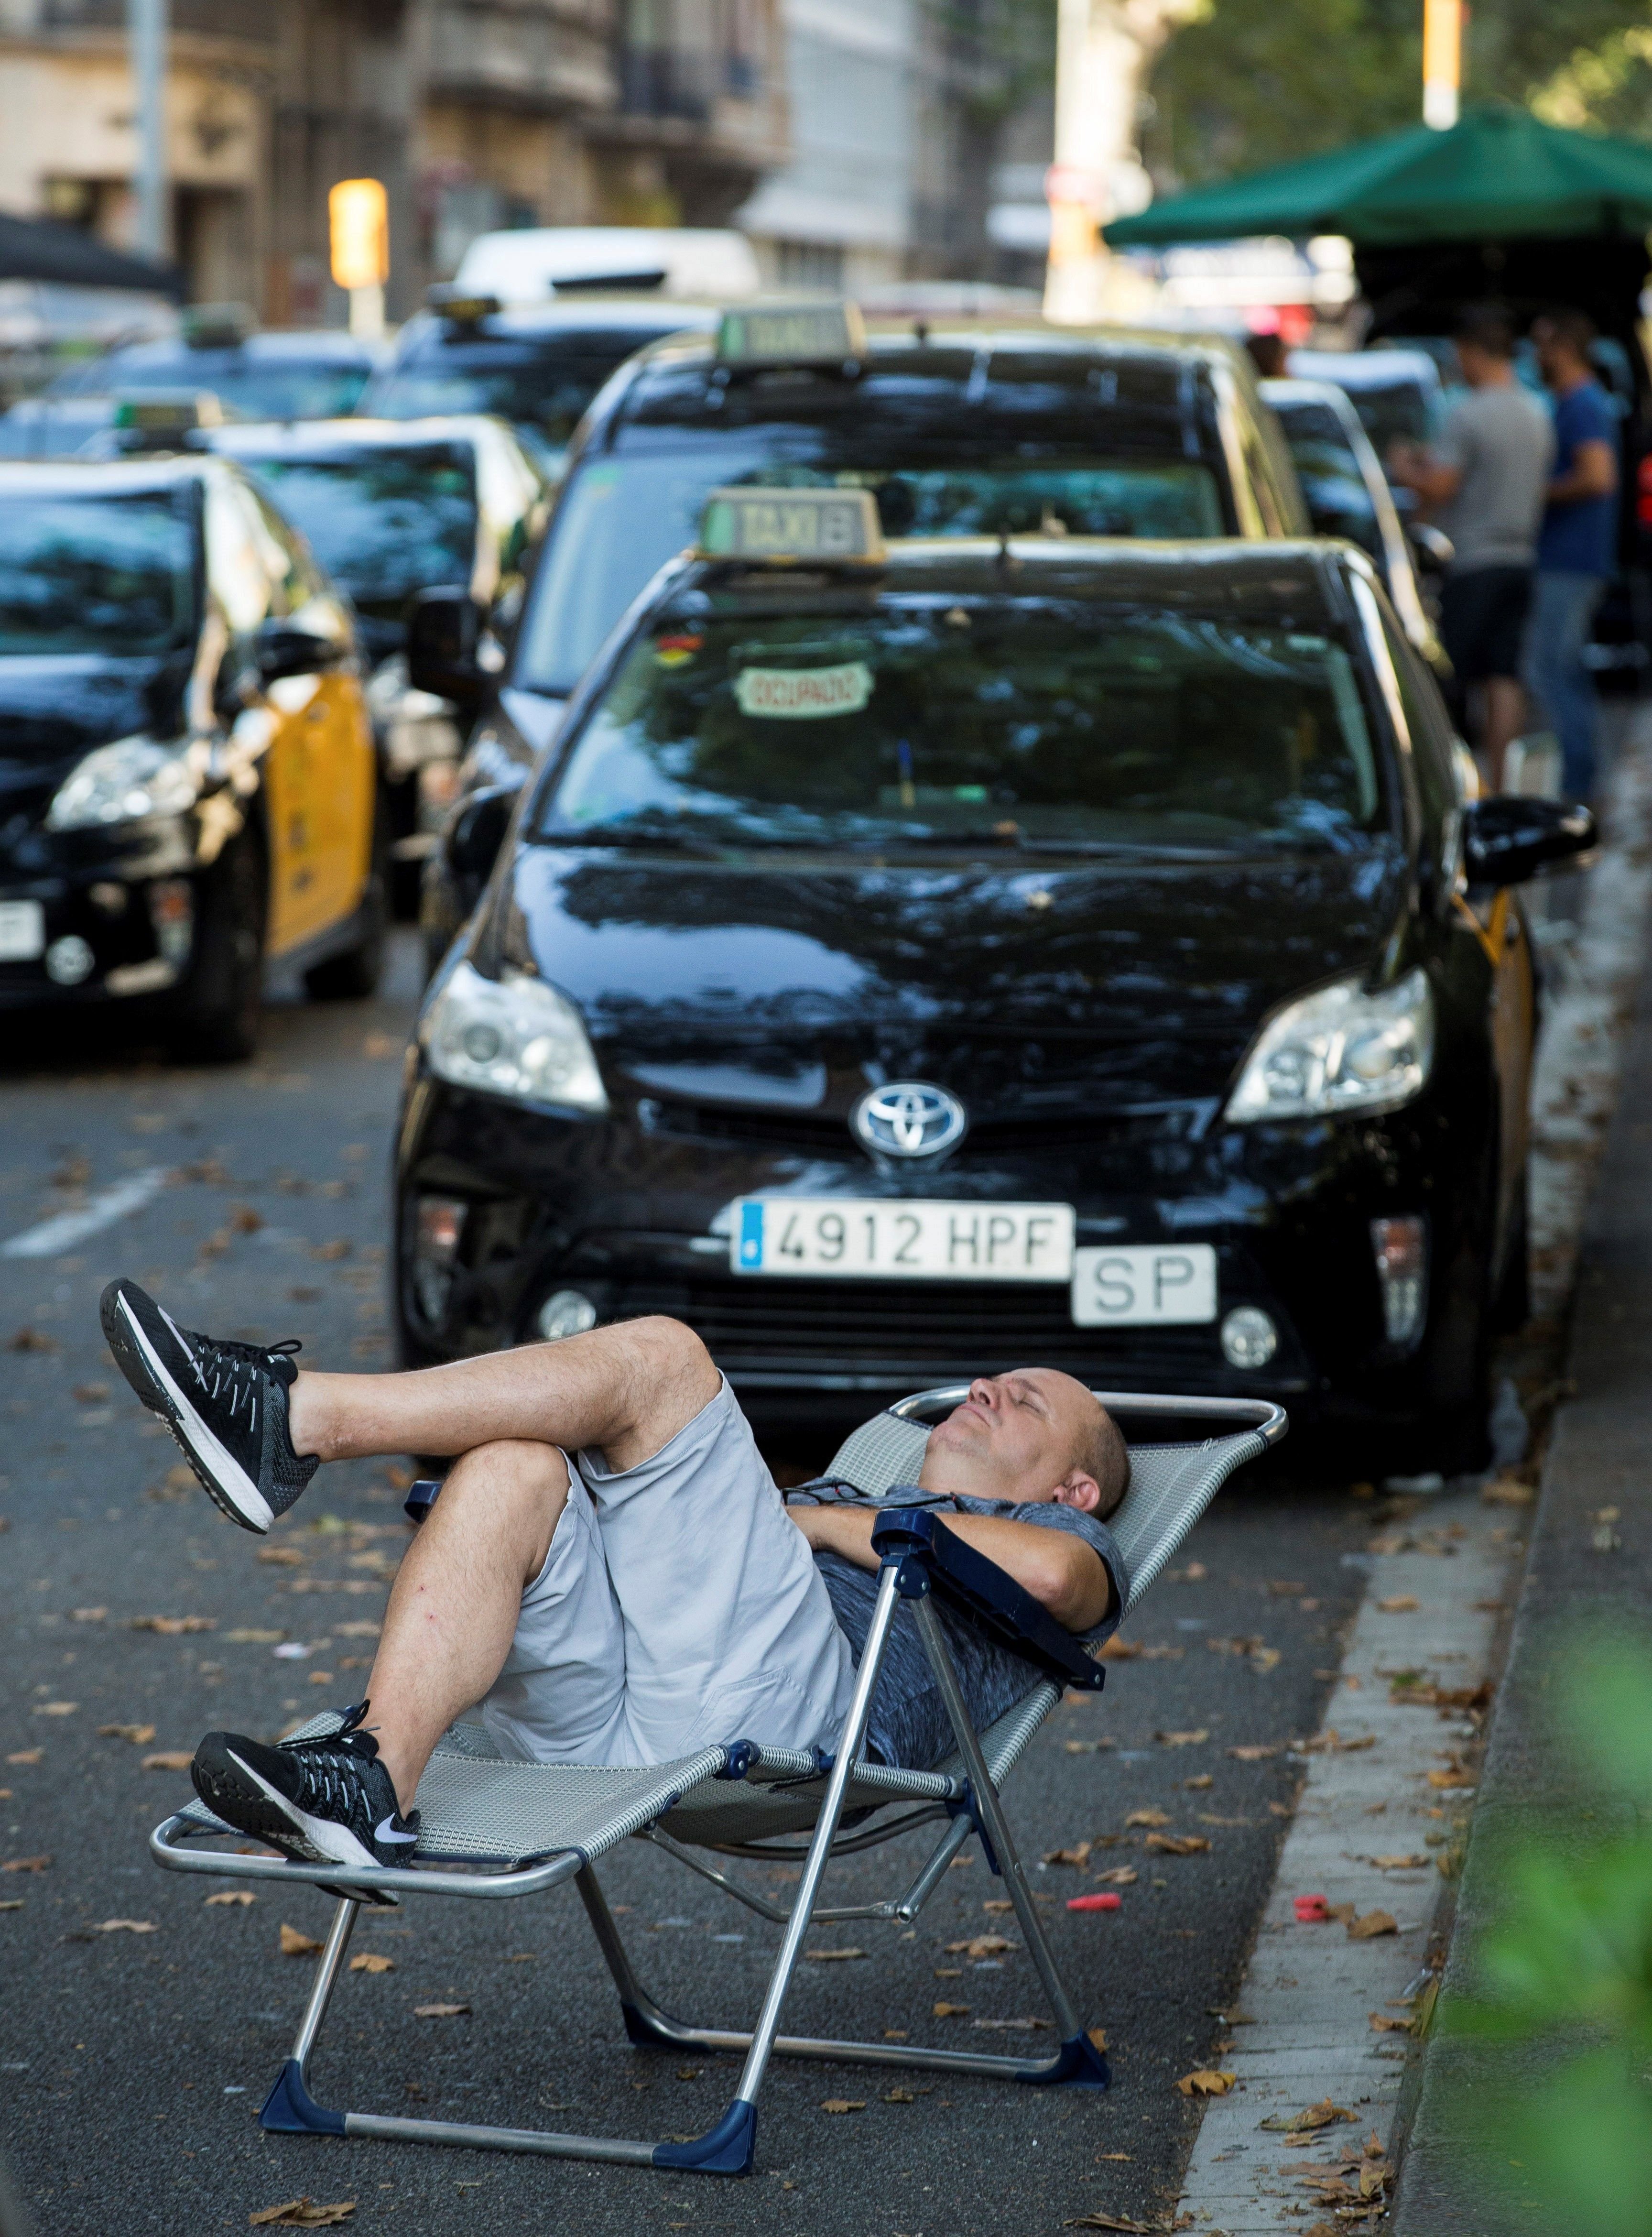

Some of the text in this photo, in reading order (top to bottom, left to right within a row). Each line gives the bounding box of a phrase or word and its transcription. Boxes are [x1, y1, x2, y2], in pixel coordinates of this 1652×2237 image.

[739, 503, 819, 551] TAXI
[778, 1211, 1056, 1266] 4912 HPF
[1094, 1255, 1196, 1314] SP
